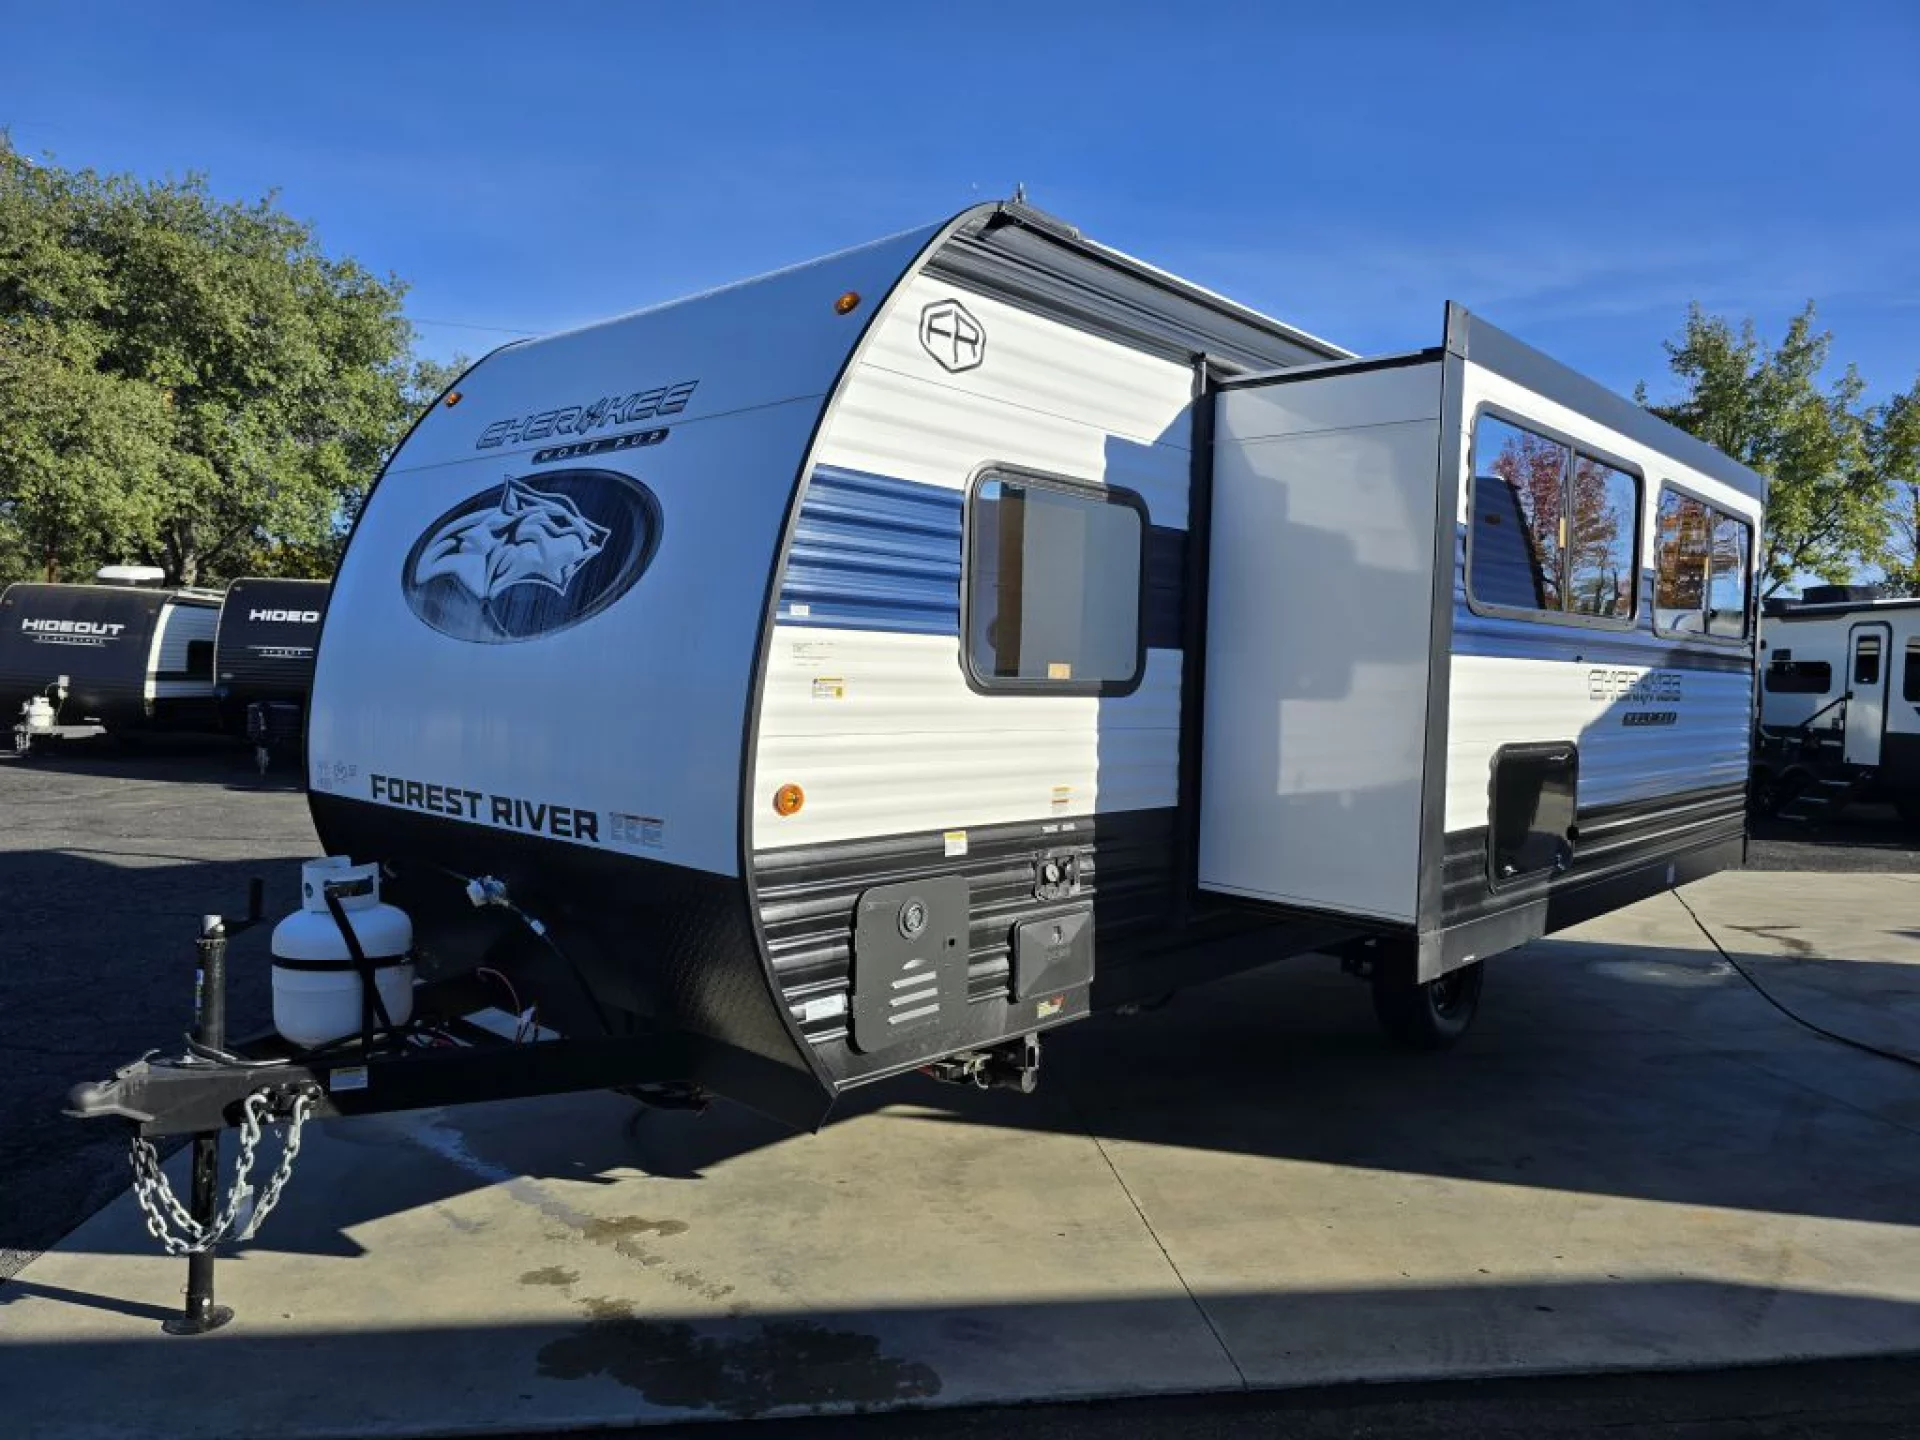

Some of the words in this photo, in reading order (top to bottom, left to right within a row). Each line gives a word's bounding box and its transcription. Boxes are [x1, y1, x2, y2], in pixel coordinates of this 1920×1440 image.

[249, 608, 320, 624] HIDEO
[22, 618, 125, 636] HIDEOUT
[370, 774, 483, 819] FOREST
[490, 794, 599, 843] RIVER
